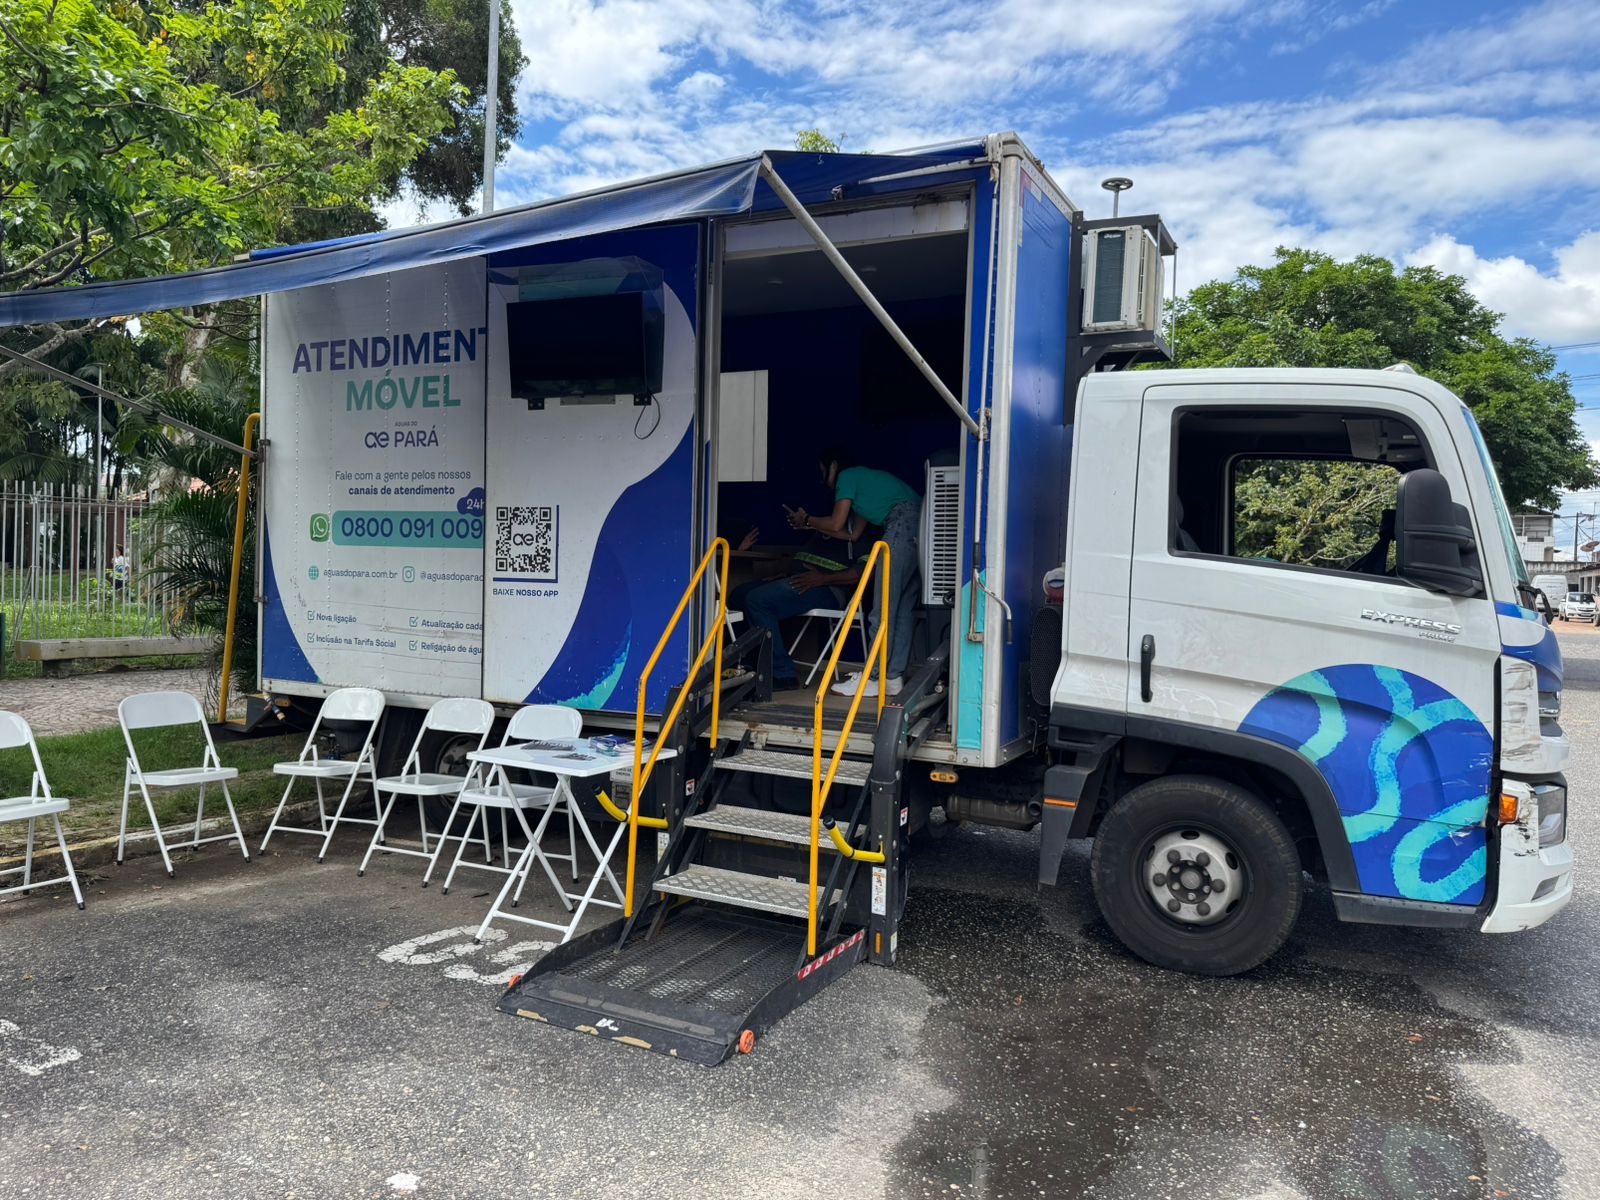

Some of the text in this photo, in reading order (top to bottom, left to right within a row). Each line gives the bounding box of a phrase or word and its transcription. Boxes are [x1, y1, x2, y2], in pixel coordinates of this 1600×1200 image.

[346, 369, 461, 411] MÓVEL
[394, 425, 439, 447] PARÁ
[335, 471, 352, 480] Fale
[375, 472, 381, 480] a
[384, 471, 409, 482] gente
[411, 470, 435, 481] pelos
[438, 470, 471, 480] nossos
[348, 484, 455, 495] canais de atendimento
[341, 517, 483, 539] 0800 091 009
[323, 568, 398, 580] aguasdopara.com.br
[492, 588, 514, 596] BAIXE
[515, 589, 542, 597] NOSSO
[316, 613, 357, 624] Nova ligação
[421, 619, 463, 630] Atualização
[1361, 608, 1461, 635] EXPRESS
[316, 634, 397, 648] Inclusão na Tarifa Social
[1418, 631, 1455, 643] PRIME
[420, 642, 456, 653] Religação
[457, 645, 467, 653] de
